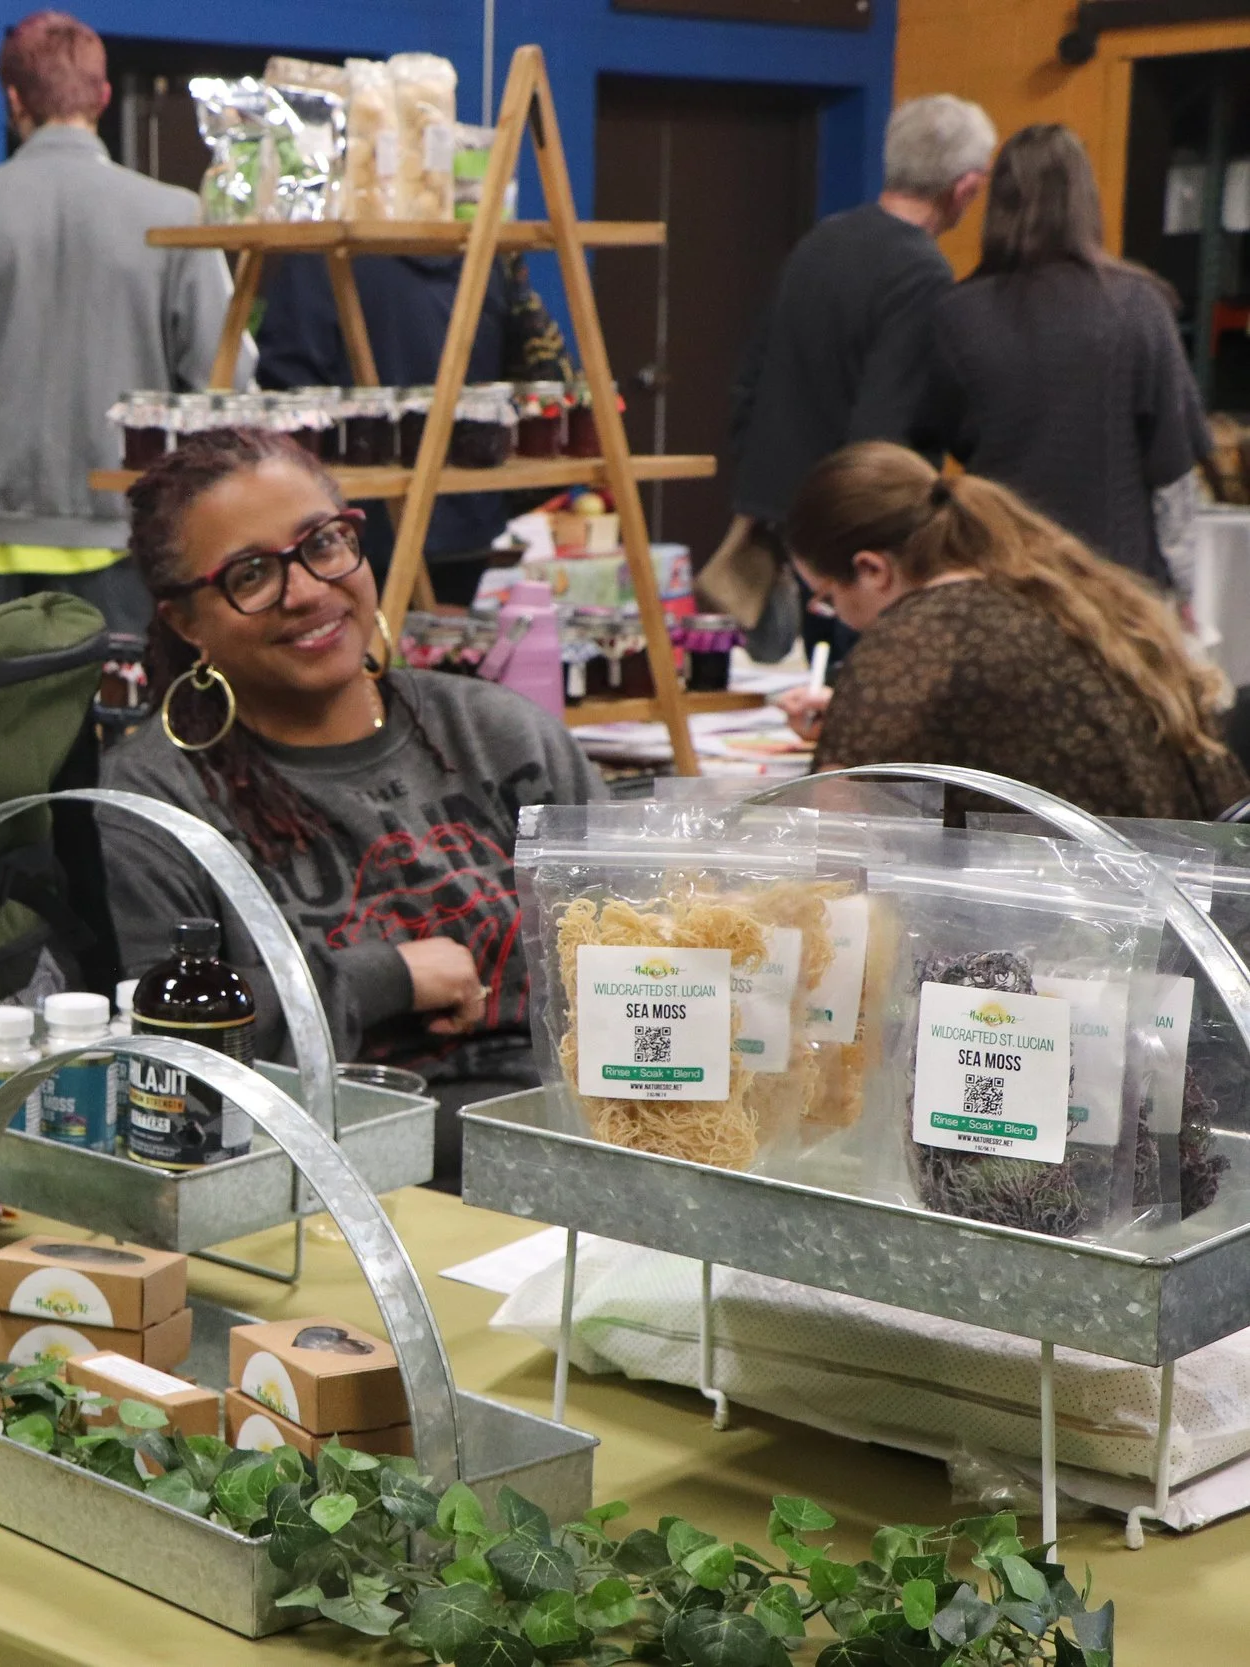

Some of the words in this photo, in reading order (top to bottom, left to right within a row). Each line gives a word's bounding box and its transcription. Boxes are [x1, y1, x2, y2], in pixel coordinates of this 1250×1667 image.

[594, 983, 664, 996] WILDCRAFTED
[665, 984, 680, 997] ST.
[681, 985, 716, 997] LUCIAN
[626, 1003, 649, 1019] SEA
[652, 1004, 687, 1020] MOSS
[1006, 1014, 1016, 1025] 92
[931, 1024, 998, 1045] WILDCRAFTED
[1000, 1033, 1015, 1047] ST.
[1017, 1035, 1054, 1052] LUCIAN
[958, 1049, 981, 1067] SEA
[985, 1052, 1022, 1071] MOSS
[605, 1067, 631, 1077] Rinse
[640, 1068, 664, 1078] Soak
[673, 1069, 701, 1079] Blend
[933, 1114, 959, 1127] Rinse
[968, 1119, 994, 1131] Soak
[1004, 1123, 1033, 1136] Blend
